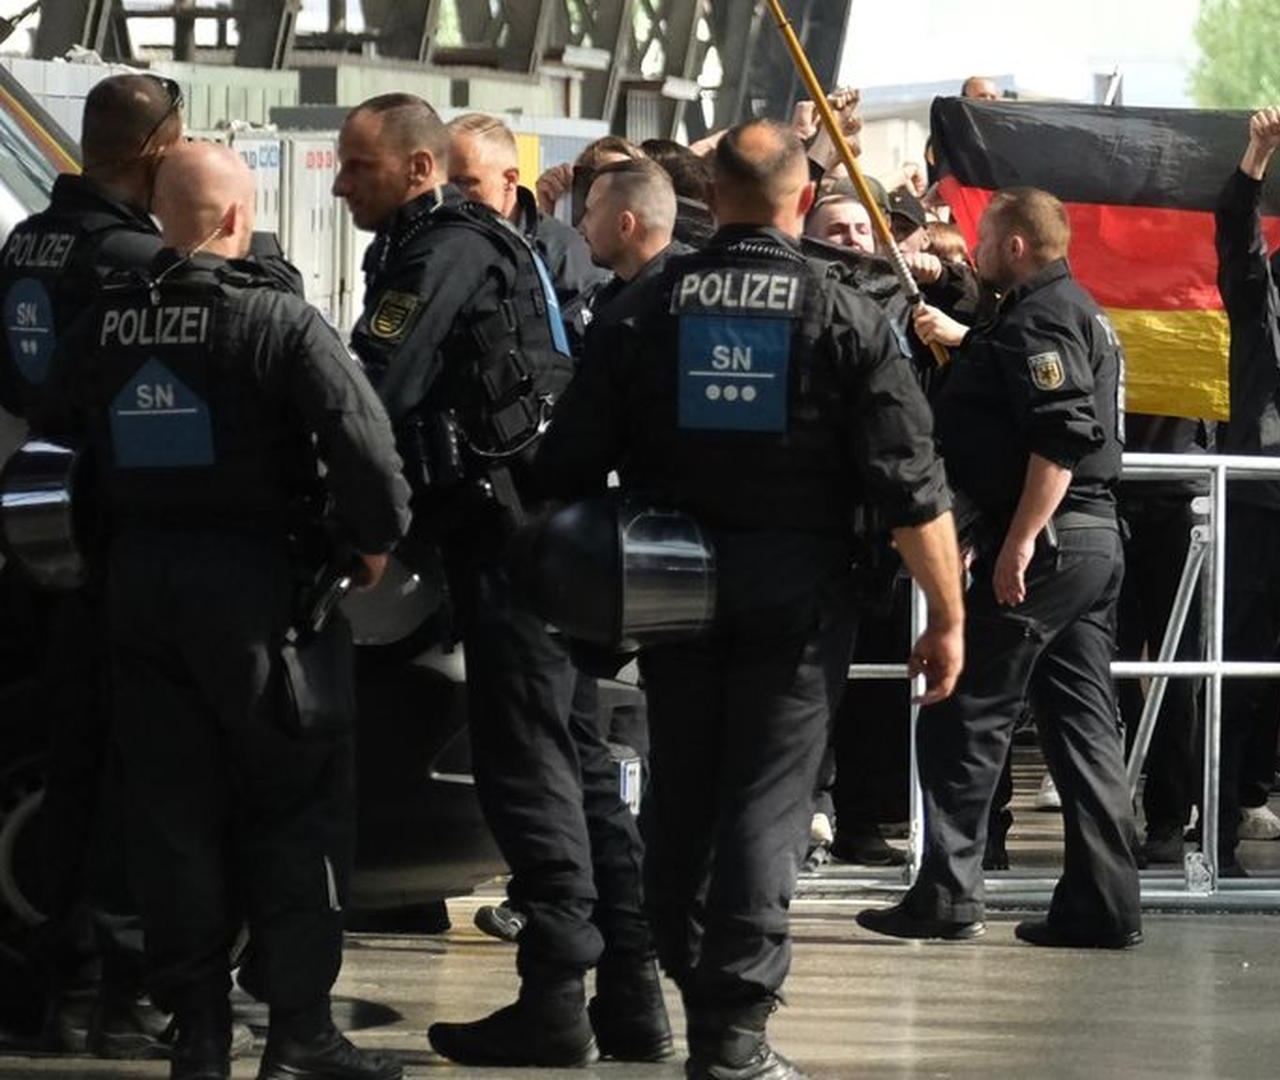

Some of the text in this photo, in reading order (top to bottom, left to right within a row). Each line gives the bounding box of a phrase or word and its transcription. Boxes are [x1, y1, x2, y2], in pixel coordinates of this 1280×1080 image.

[4, 233, 76, 267] POLIZEI
[680, 273, 799, 310] POLIZEI
[17, 303, 38, 326] SN
[101, 307, 209, 346] POLIZEI
[712, 345, 751, 370] SN
[136, 385, 173, 408] SN
